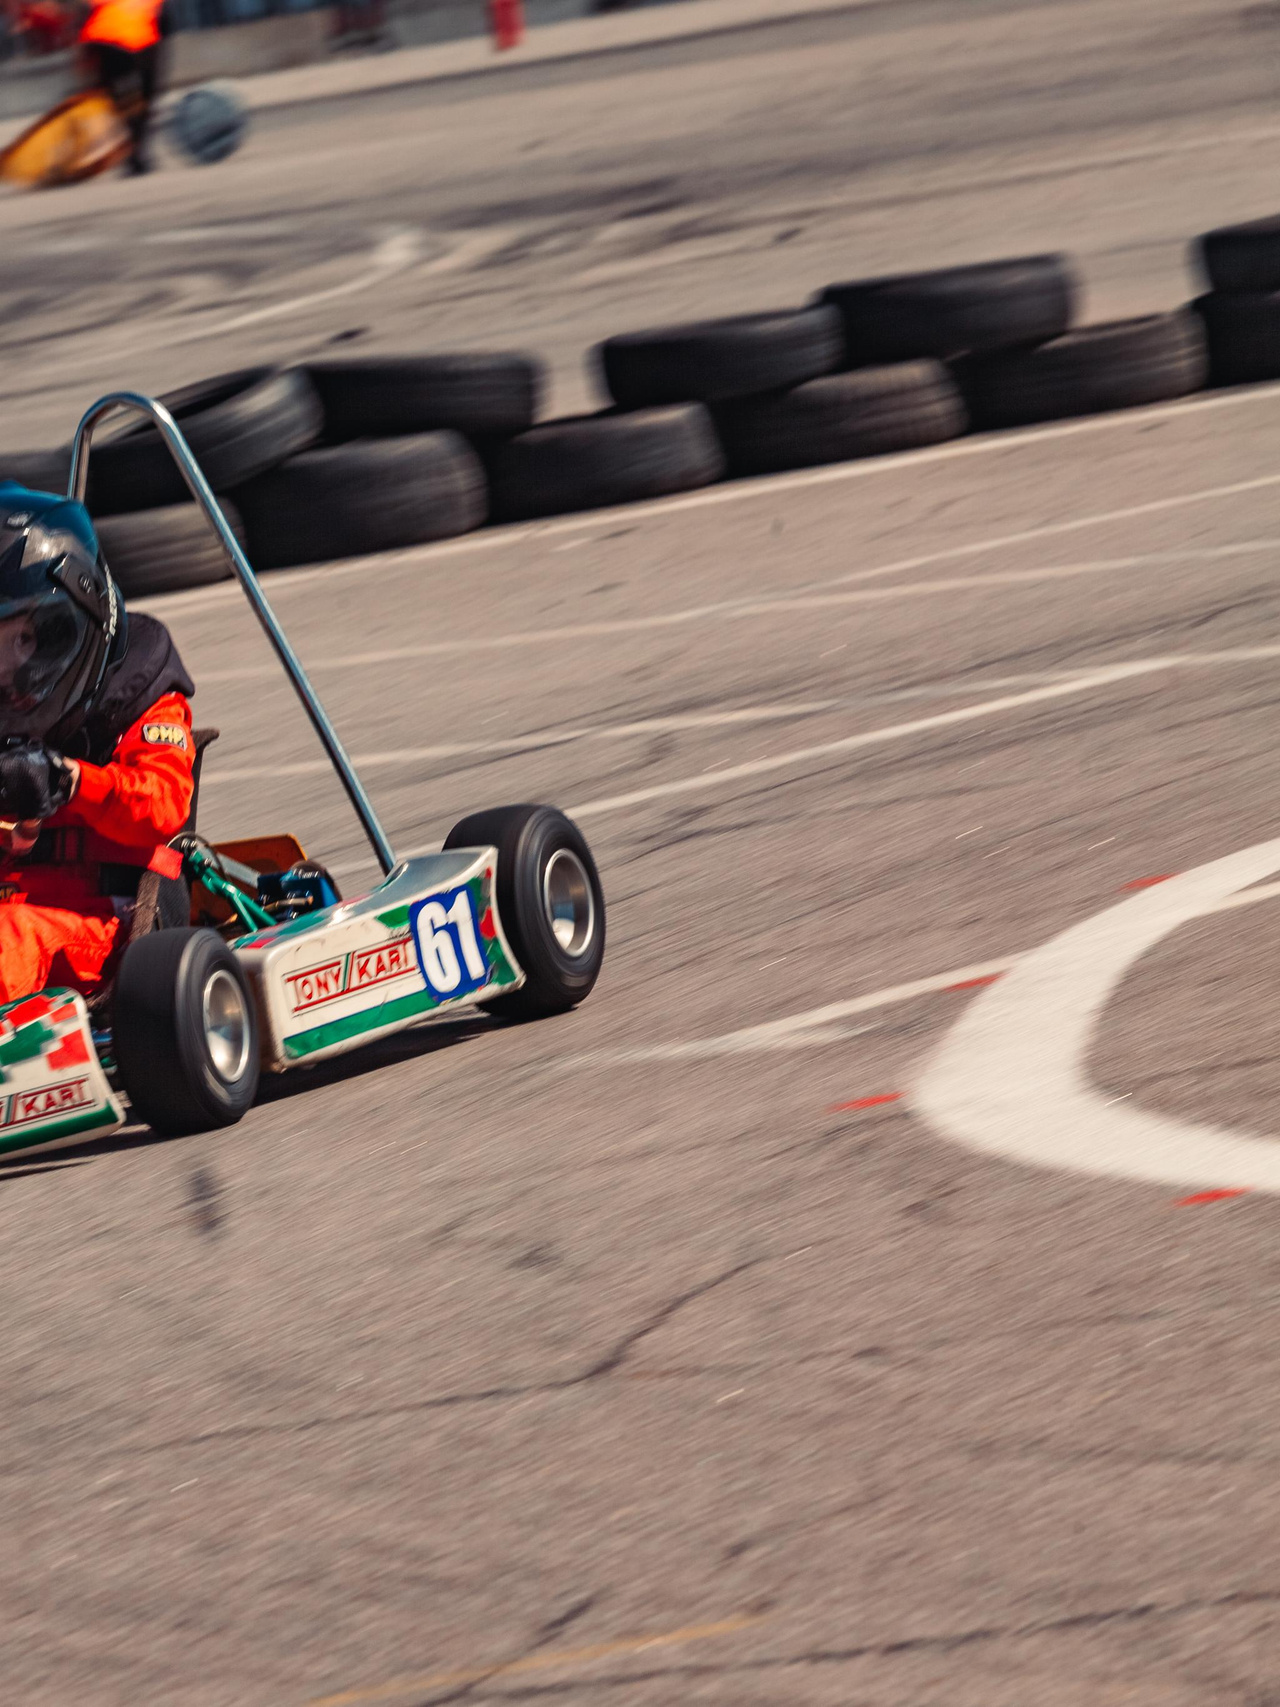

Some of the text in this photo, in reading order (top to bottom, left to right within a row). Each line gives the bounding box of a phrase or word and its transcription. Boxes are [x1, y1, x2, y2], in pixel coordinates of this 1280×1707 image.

[286, 937, 415, 1004] TONY KART
[416, 890, 486, 993] 61
[20, 1077, 89, 1117] KART
